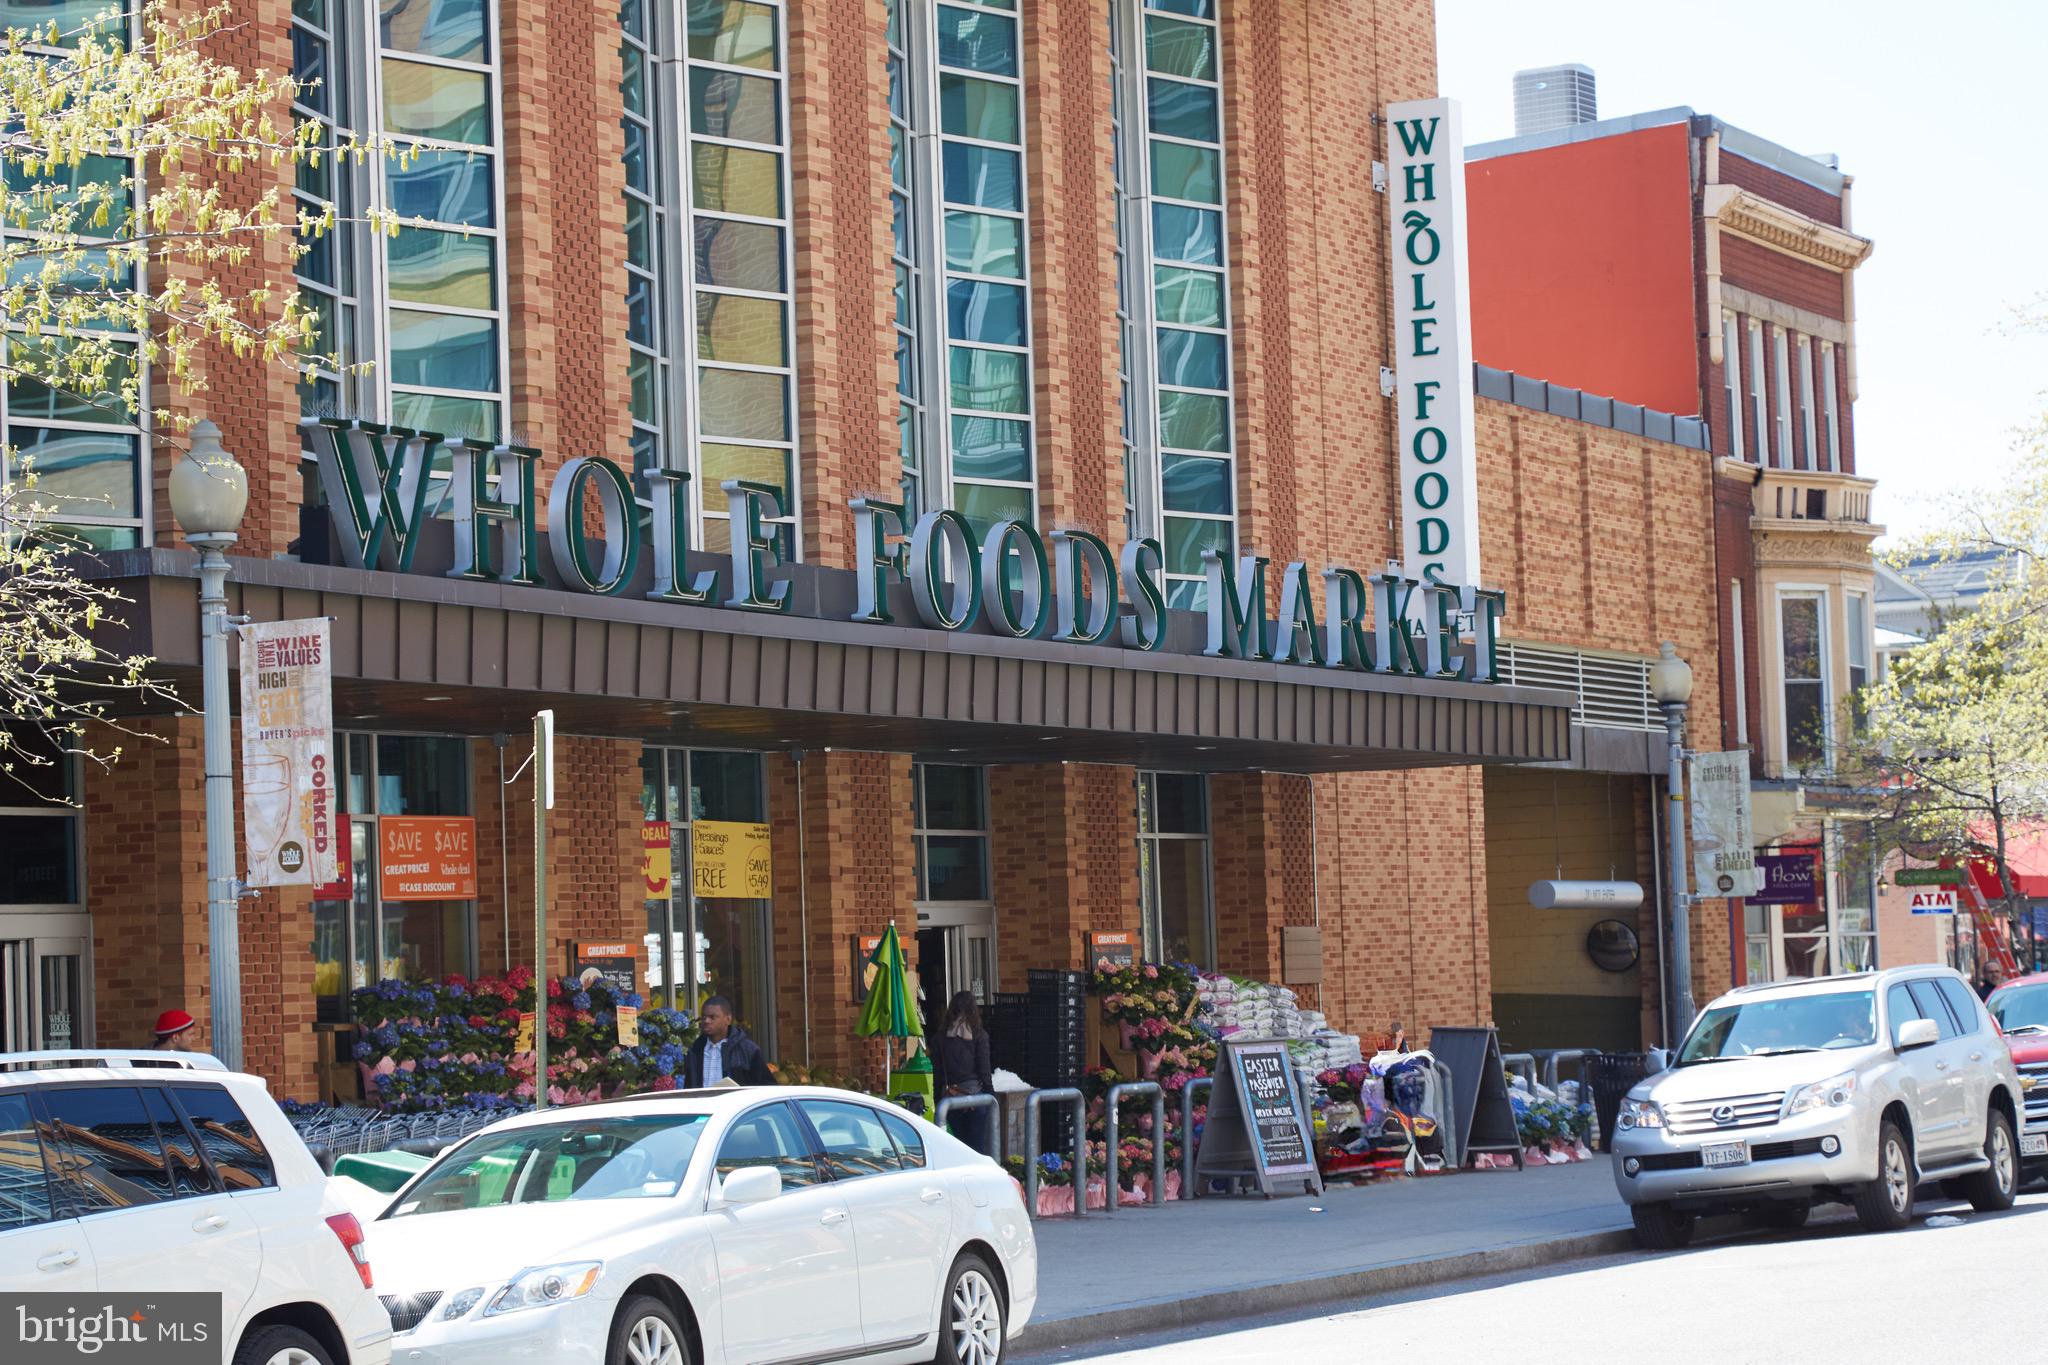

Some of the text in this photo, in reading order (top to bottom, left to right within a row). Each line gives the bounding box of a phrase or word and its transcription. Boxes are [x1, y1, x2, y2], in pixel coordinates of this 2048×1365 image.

[1393, 117, 1440, 357] WHOLE
[301, 416, 1506, 683] WHOLE FOODS MARKET
[275, 635, 321, 650] WINE
[276, 648, 321, 667] VALUES
[258, 671, 287, 689] HIGH
[311, 754, 328, 853] CORKED
[641, 827, 669, 840] DEAL!
[694, 829, 730, 846] Dressings
[700, 843, 725, 855] Sauces
[385, 862, 430, 875] GREAT PRICE!
[748, 858, 769, 872] SAVE
[1772, 863, 1810, 882] flow
[695, 867, 728, 888] FREE
[405, 882, 422, 892] CASE
[423, 882, 456, 892] DISCOUNT
[1912, 893, 1952, 906] ATM
[1244, 1057, 1280, 1073] EASTER
[1248, 1076, 1286, 1091] PASSOVER
[1257, 1089, 1280, 1099] MENU
